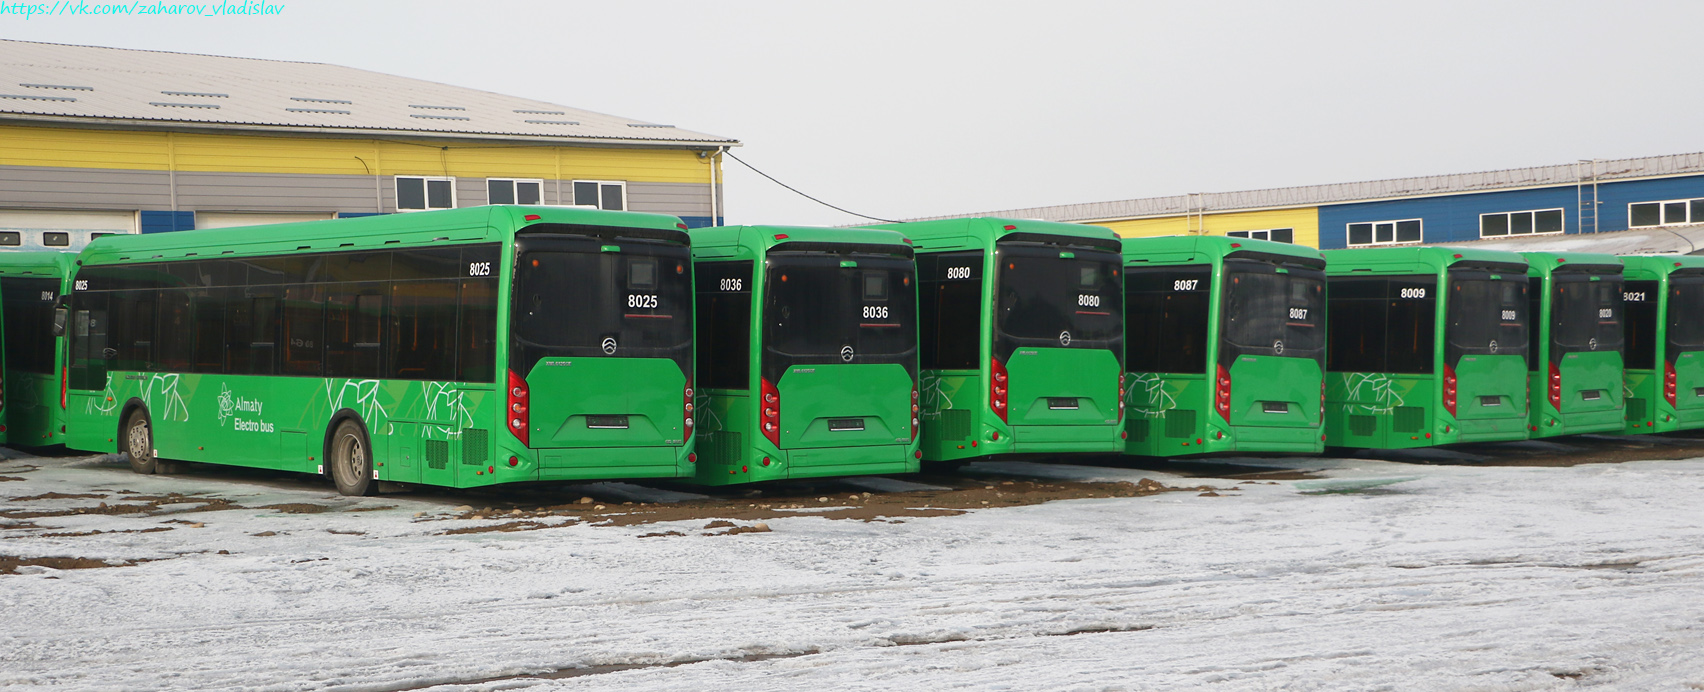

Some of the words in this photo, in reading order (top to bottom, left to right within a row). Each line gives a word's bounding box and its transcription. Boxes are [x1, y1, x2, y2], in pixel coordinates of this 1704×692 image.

[469, 262, 491, 276] 8025
[947, 267, 971, 279] 8080
[75, 280, 88, 290] 8025
[719, 278, 742, 291] 8036
[1173, 280, 1199, 291] 8087
[41, 291, 54, 300] 8014
[1400, 288, 1426, 298] 8009
[628, 294, 658, 308] 8025
[1078, 295, 1100, 307] 8080
[862, 306, 889, 318] 8036
[1289, 308, 1308, 319] 8087
[1501, 310, 1516, 320] 8009
[1599, 308, 1612, 318] 8020
[234, 396, 263, 416] Almaty
[234, 417, 259, 432] Electro
[260, 419, 275, 433] bus
